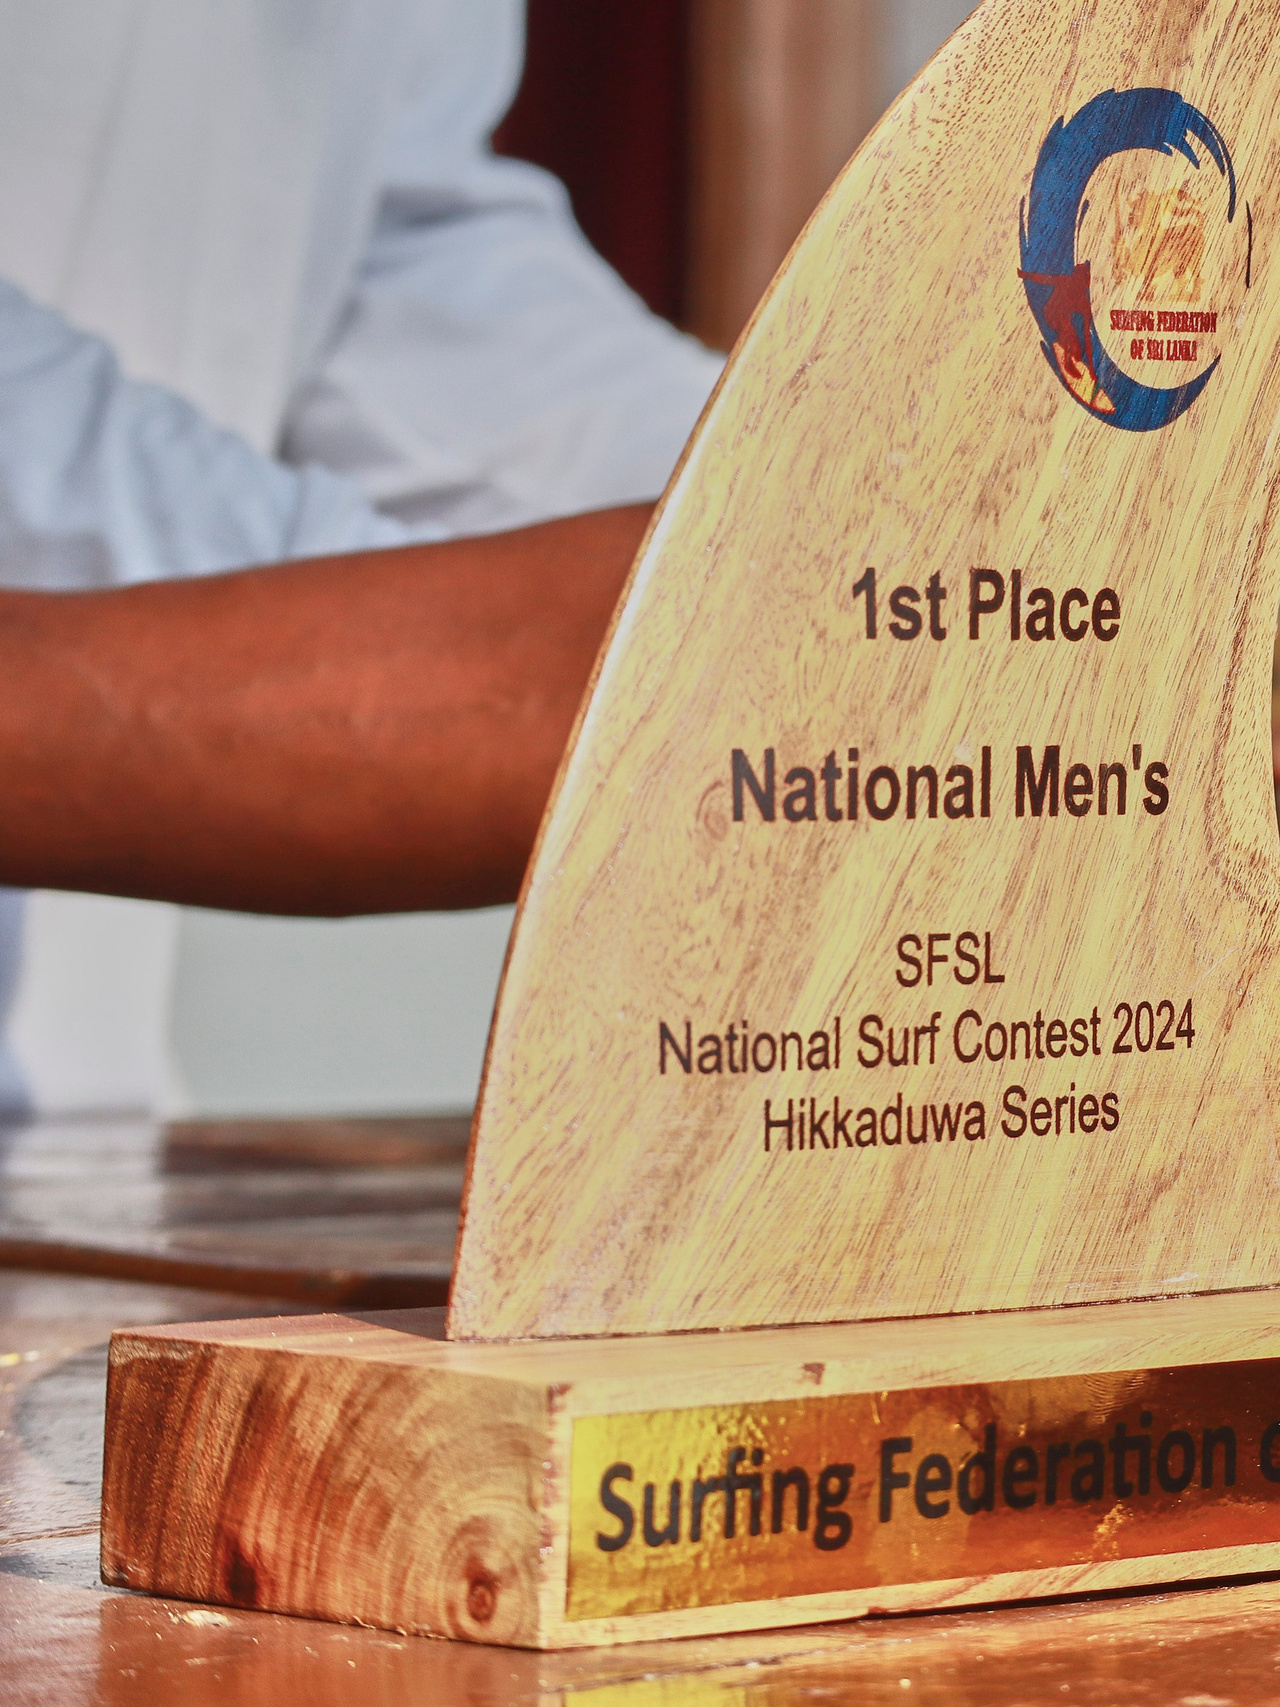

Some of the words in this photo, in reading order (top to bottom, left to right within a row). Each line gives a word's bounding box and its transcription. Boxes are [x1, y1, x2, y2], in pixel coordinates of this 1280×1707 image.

[1110, 309, 1155, 331] SURFING
[1156, 310, 1217, 333] FEDERATION
[1130, 338, 1145, 360] OF
[1146, 338, 1164, 360] SRI
[1165, 339, 1198, 361] LANKA
[852, 567, 947, 641] 1st
[968, 567, 1121, 642] Place
[731, 746, 992, 823] National
[1015, 743, 1170, 818] Men's
[895, 931, 1006, 988] SFSL
[659, 1016, 841, 1075] National
[857, 1011, 942, 1069] Surf
[952, 1005, 1102, 1064] Contest
[1111, 998, 1196, 1055] 2024
[764, 1092, 986, 1152] Hikkaduwa
[1000, 1084, 1120, 1139] Series
[596, 1446, 855, 1553] Surfing
[879, 1411, 1237, 1523] Federation
